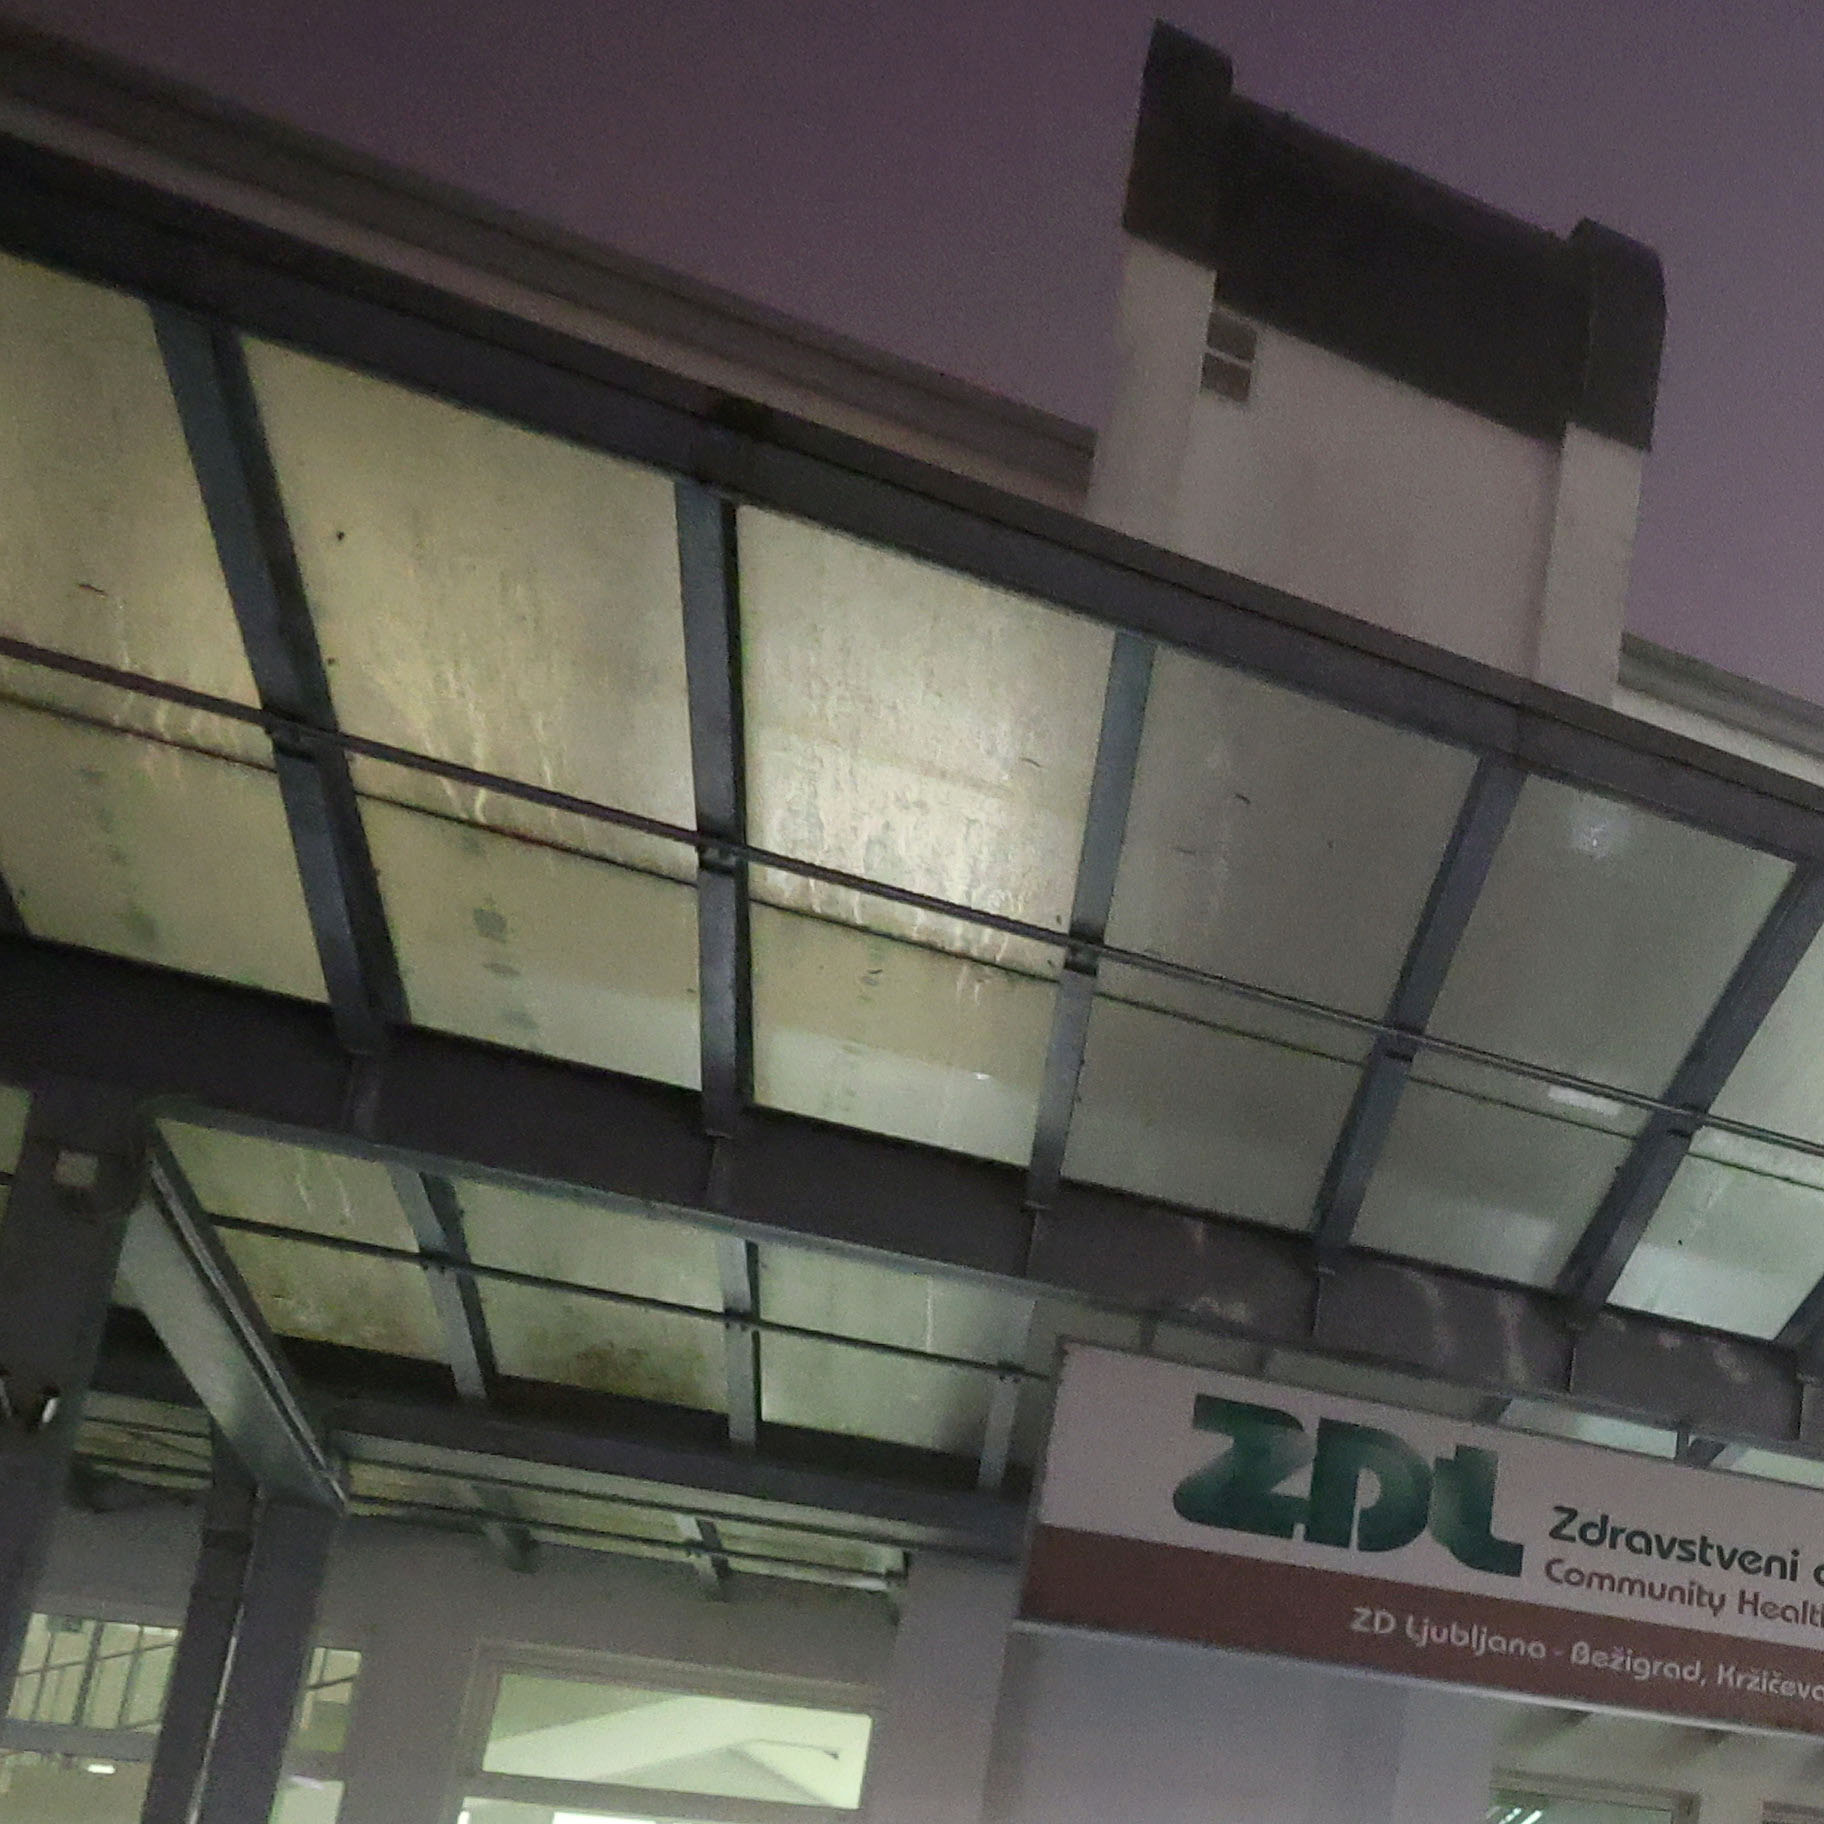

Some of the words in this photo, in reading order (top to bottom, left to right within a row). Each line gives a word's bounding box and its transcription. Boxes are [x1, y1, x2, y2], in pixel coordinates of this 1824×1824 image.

[1549, 1505, 1799, 1582] Zdravstveni
[1545, 1558, 1726, 1617] Community
[1351, 1606, 1396, 1634] ZD
[1405, 1615, 1547, 1659] Ljubljana
[1571, 1641, 1707, 1687] Bežigrad,
